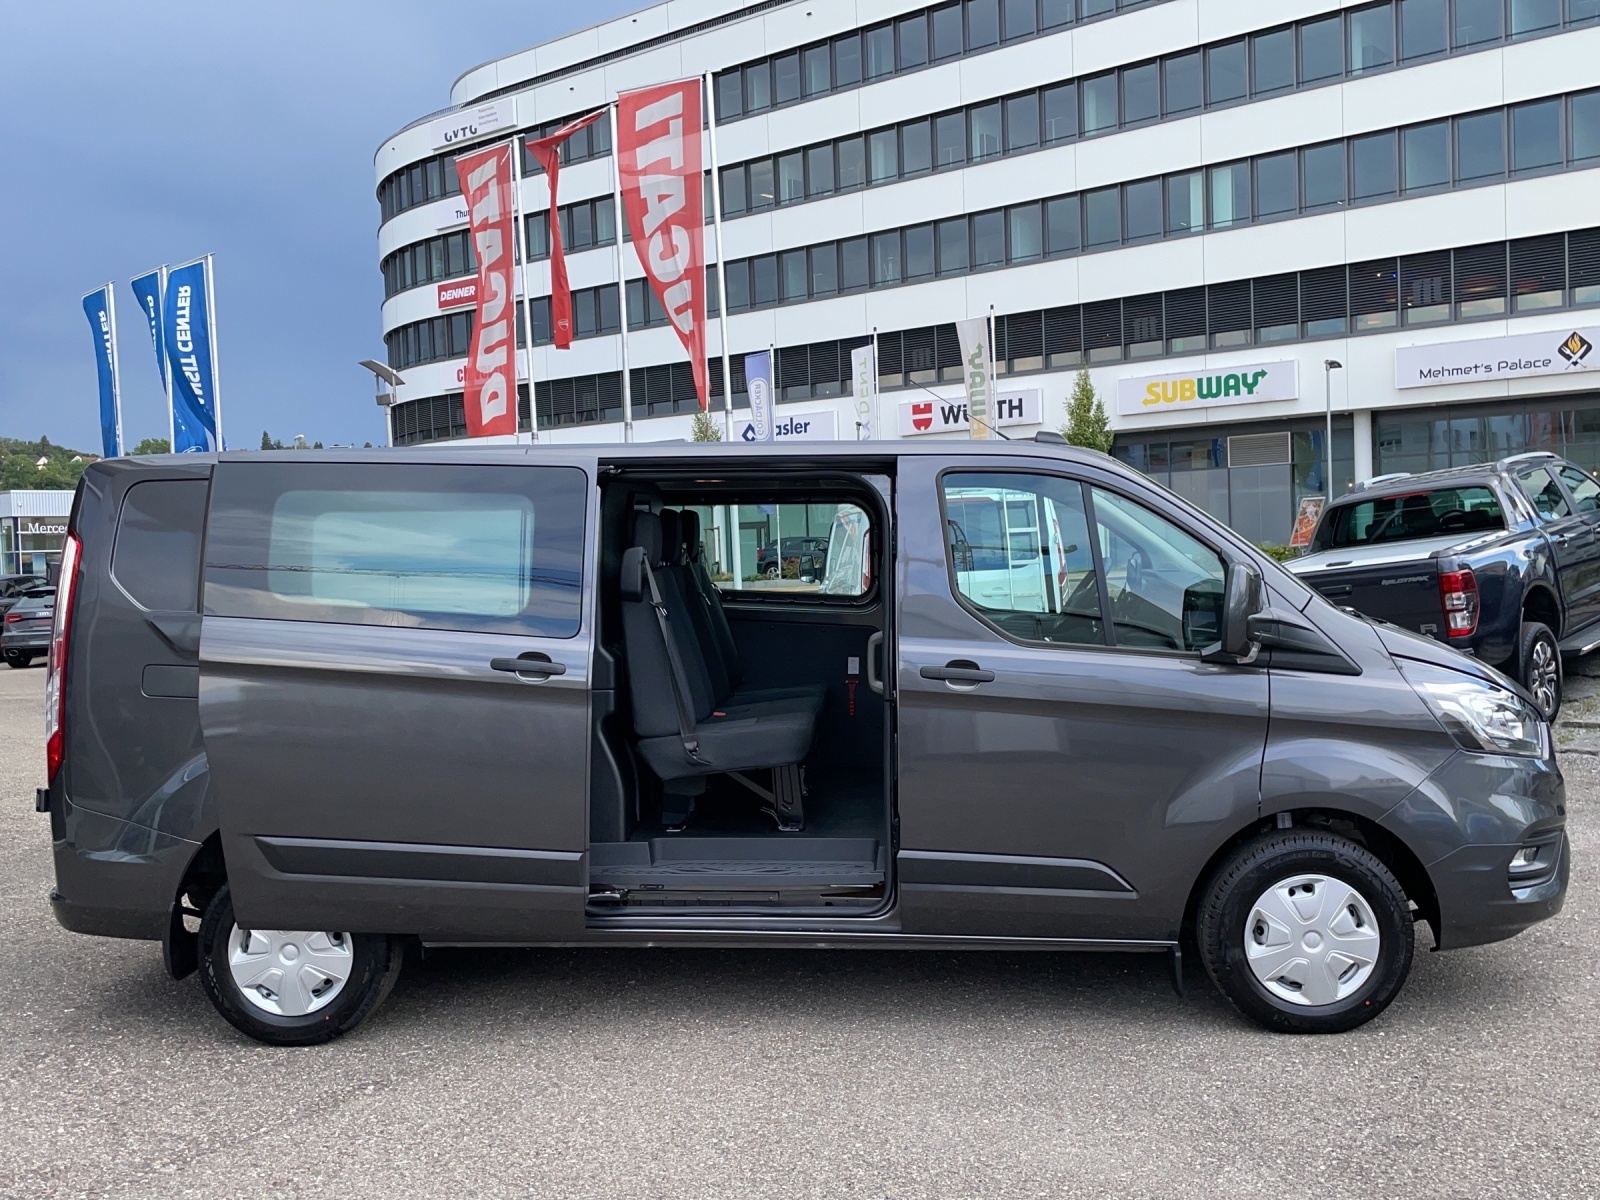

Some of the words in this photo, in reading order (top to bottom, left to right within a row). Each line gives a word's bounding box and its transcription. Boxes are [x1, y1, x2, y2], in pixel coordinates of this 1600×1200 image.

[440, 285, 476, 301] DENNER
[1419, 364, 1492, 380] Mehmet's
[1497, 358, 1552, 372] Palace
[1141, 368, 1268, 407] SUBWAY
[940, 398, 1023, 425] WTH
[776, 417, 810, 436] asler
